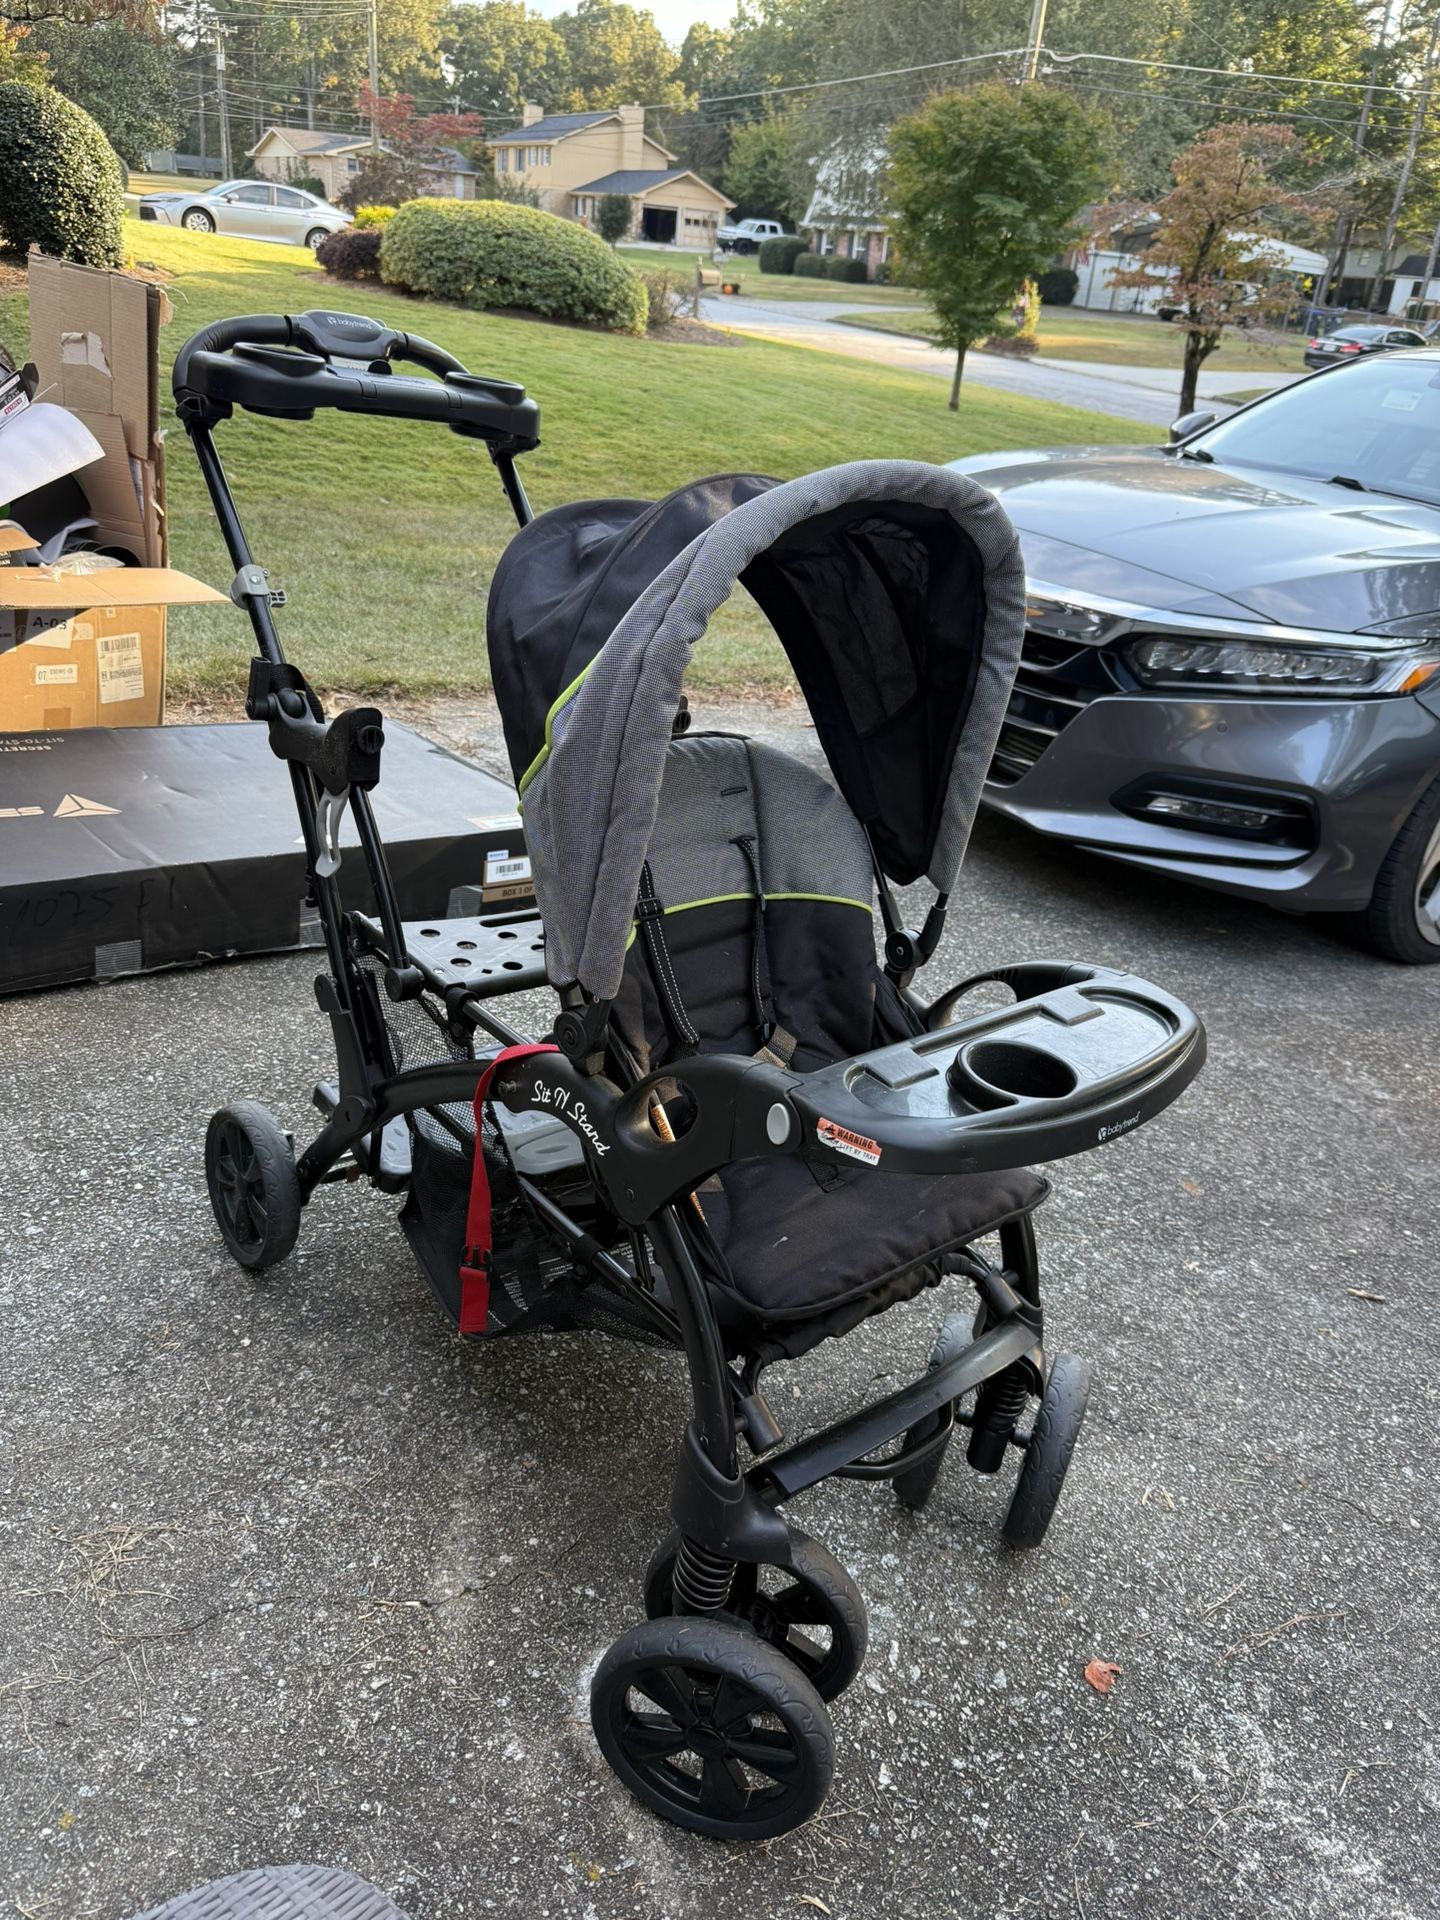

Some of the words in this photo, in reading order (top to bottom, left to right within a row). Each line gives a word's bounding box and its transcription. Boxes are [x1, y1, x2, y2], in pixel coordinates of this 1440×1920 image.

[33, 616, 67, 630] A-03
[502, 888, 516, 897] BOX
[531, 1080, 551, 1103] Sit
[567, 1102, 611, 1156] Stand
[837, 1128, 874, 1150] WARNING
